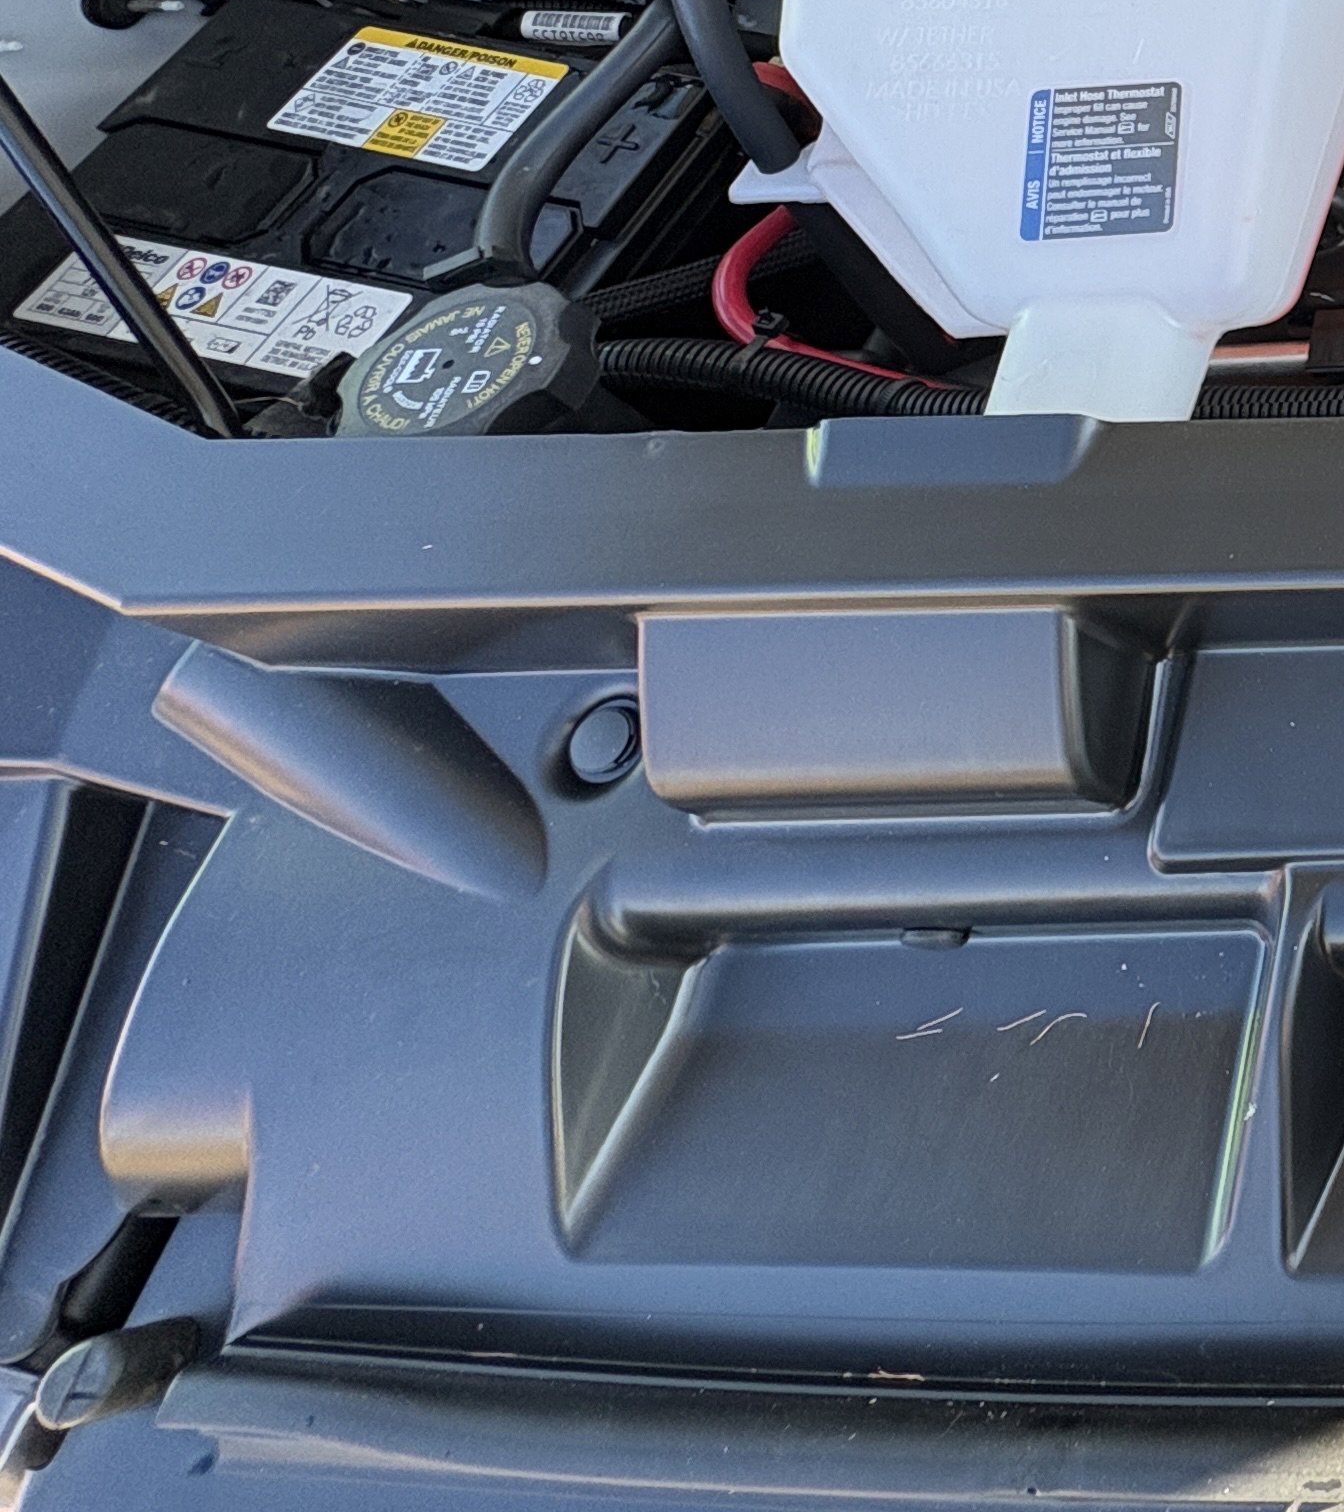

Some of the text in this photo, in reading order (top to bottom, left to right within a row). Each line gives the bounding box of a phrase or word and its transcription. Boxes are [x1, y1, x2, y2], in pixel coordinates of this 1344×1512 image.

[1055, 91, 1078, 103] Inlet
[1107, 86, 1165, 100] Thermostat
[1031, 99, 1047, 144] NOTICE
[1051, 147, 1162, 163] Thermostat et flexible
[1025, 179, 1041, 210] AVIS
[120, 243, 171, 265] Delco
[494, 355, 525, 384] OPEN
